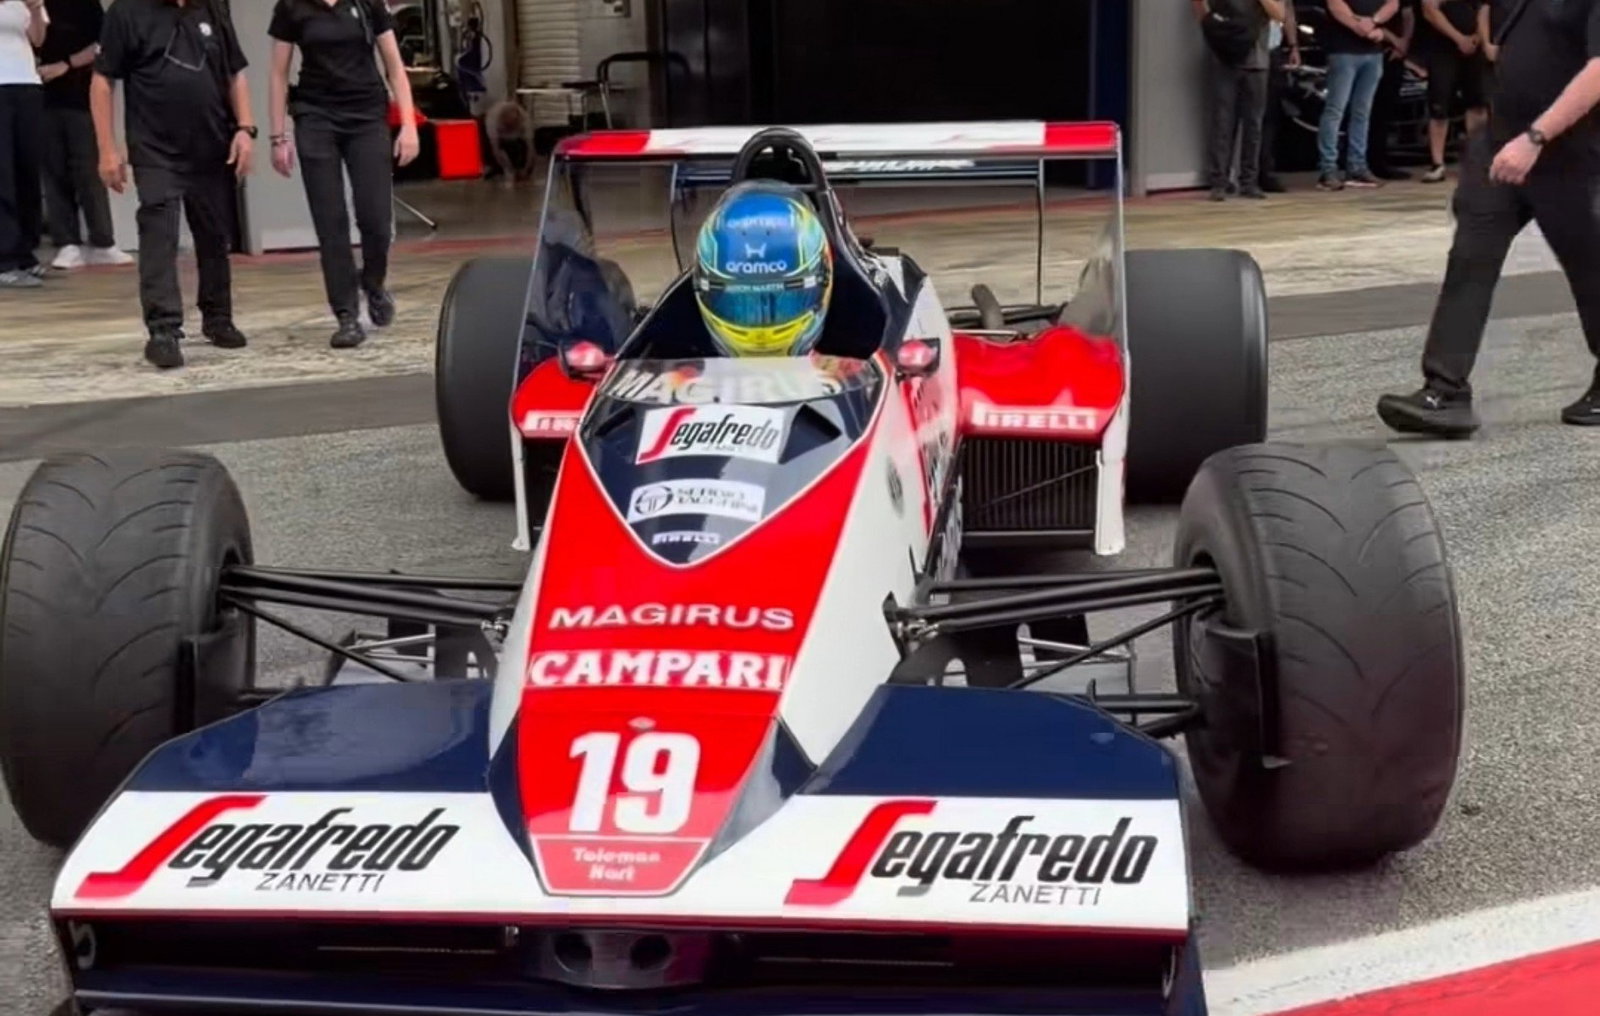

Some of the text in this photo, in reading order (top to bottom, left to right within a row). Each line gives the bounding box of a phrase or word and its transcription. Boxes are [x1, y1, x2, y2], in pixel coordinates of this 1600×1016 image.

[725, 260, 788, 274] aramco
[971, 402, 1097, 430] PIRELLI
[637, 404, 781, 461] Segafredo
[548, 603, 794, 630] MAGIRUS
[531, 651, 787, 688] CAMPARI
[569, 732, 701, 834] 19
[73, 795, 460, 899] Segafredo
[783, 801, 1158, 905] Segafredo
[254, 873, 385, 893] ZANETTI
[969, 883, 1101, 907] ZANETTI
